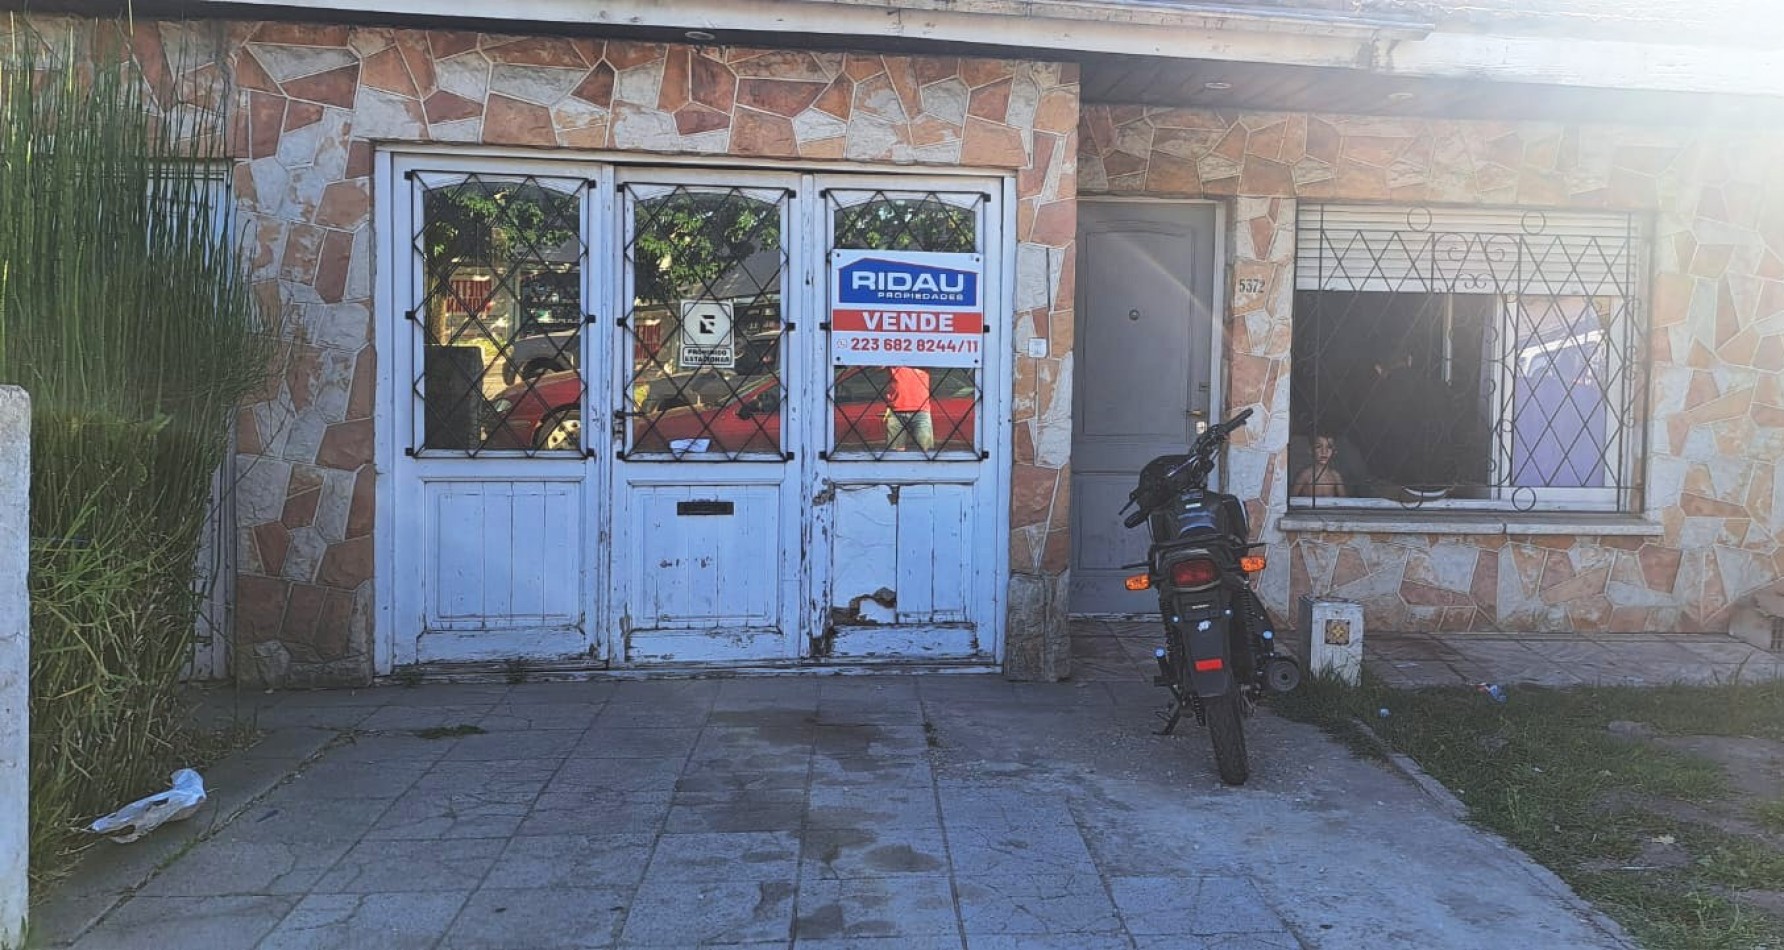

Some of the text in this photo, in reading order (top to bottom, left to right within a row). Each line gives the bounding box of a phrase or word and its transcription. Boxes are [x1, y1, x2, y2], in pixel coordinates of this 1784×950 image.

[852, 271, 964, 292] RIDAU
[878, 292, 964, 301] PROPIEDADES
[862, 311, 954, 332] VENDE
[851, 337, 979, 353] 223 682 8244/11
